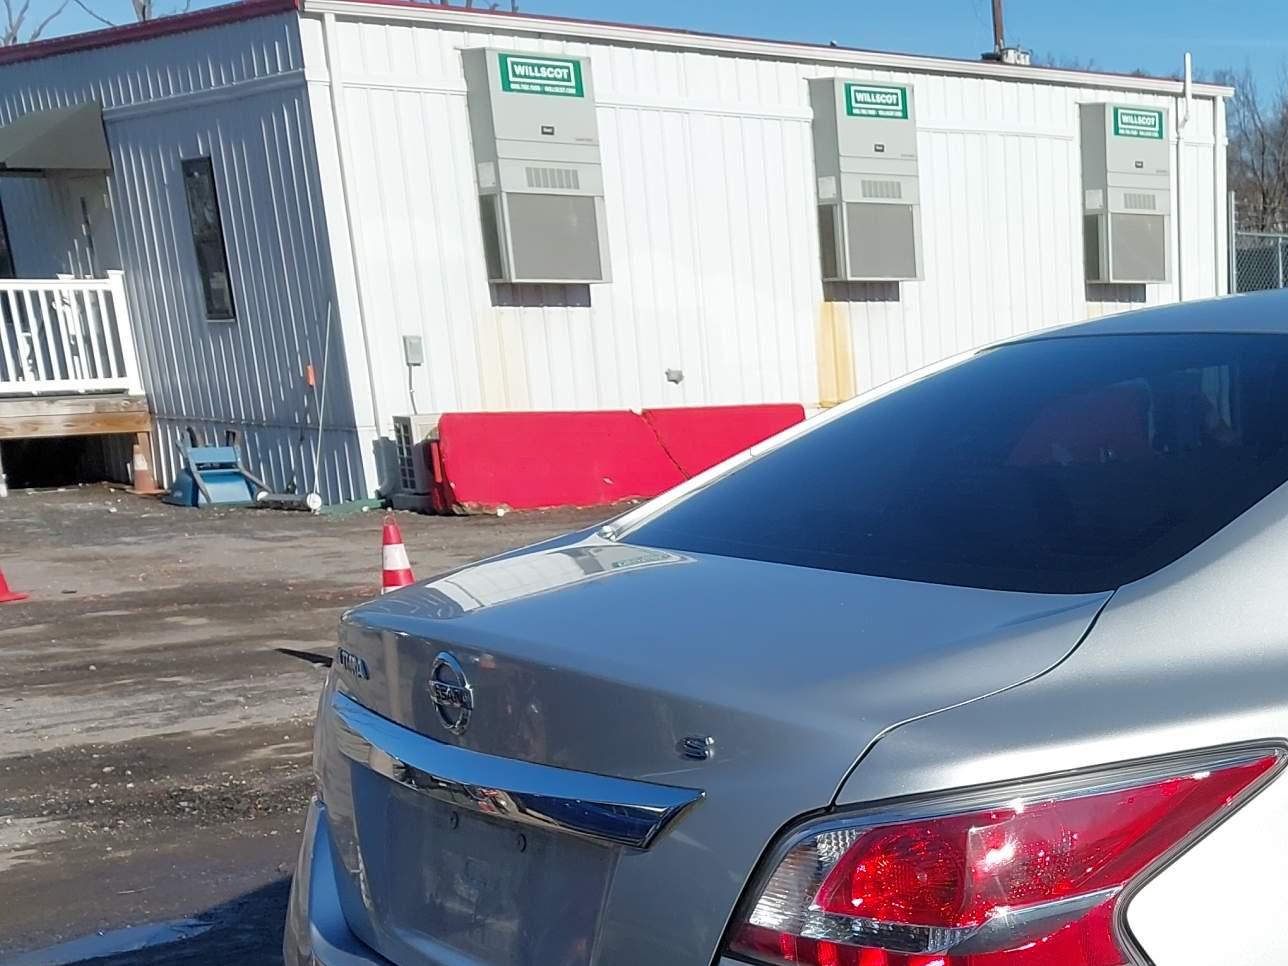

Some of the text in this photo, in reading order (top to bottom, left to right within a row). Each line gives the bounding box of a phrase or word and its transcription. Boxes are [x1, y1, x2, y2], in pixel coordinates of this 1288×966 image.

[513, 64, 569, 80] WILLSCOT
[855, 92, 898, 105] WILLSCOT
[1121, 114, 1155, 126] WILLSCOT
[679, 736, 715, 761] S
